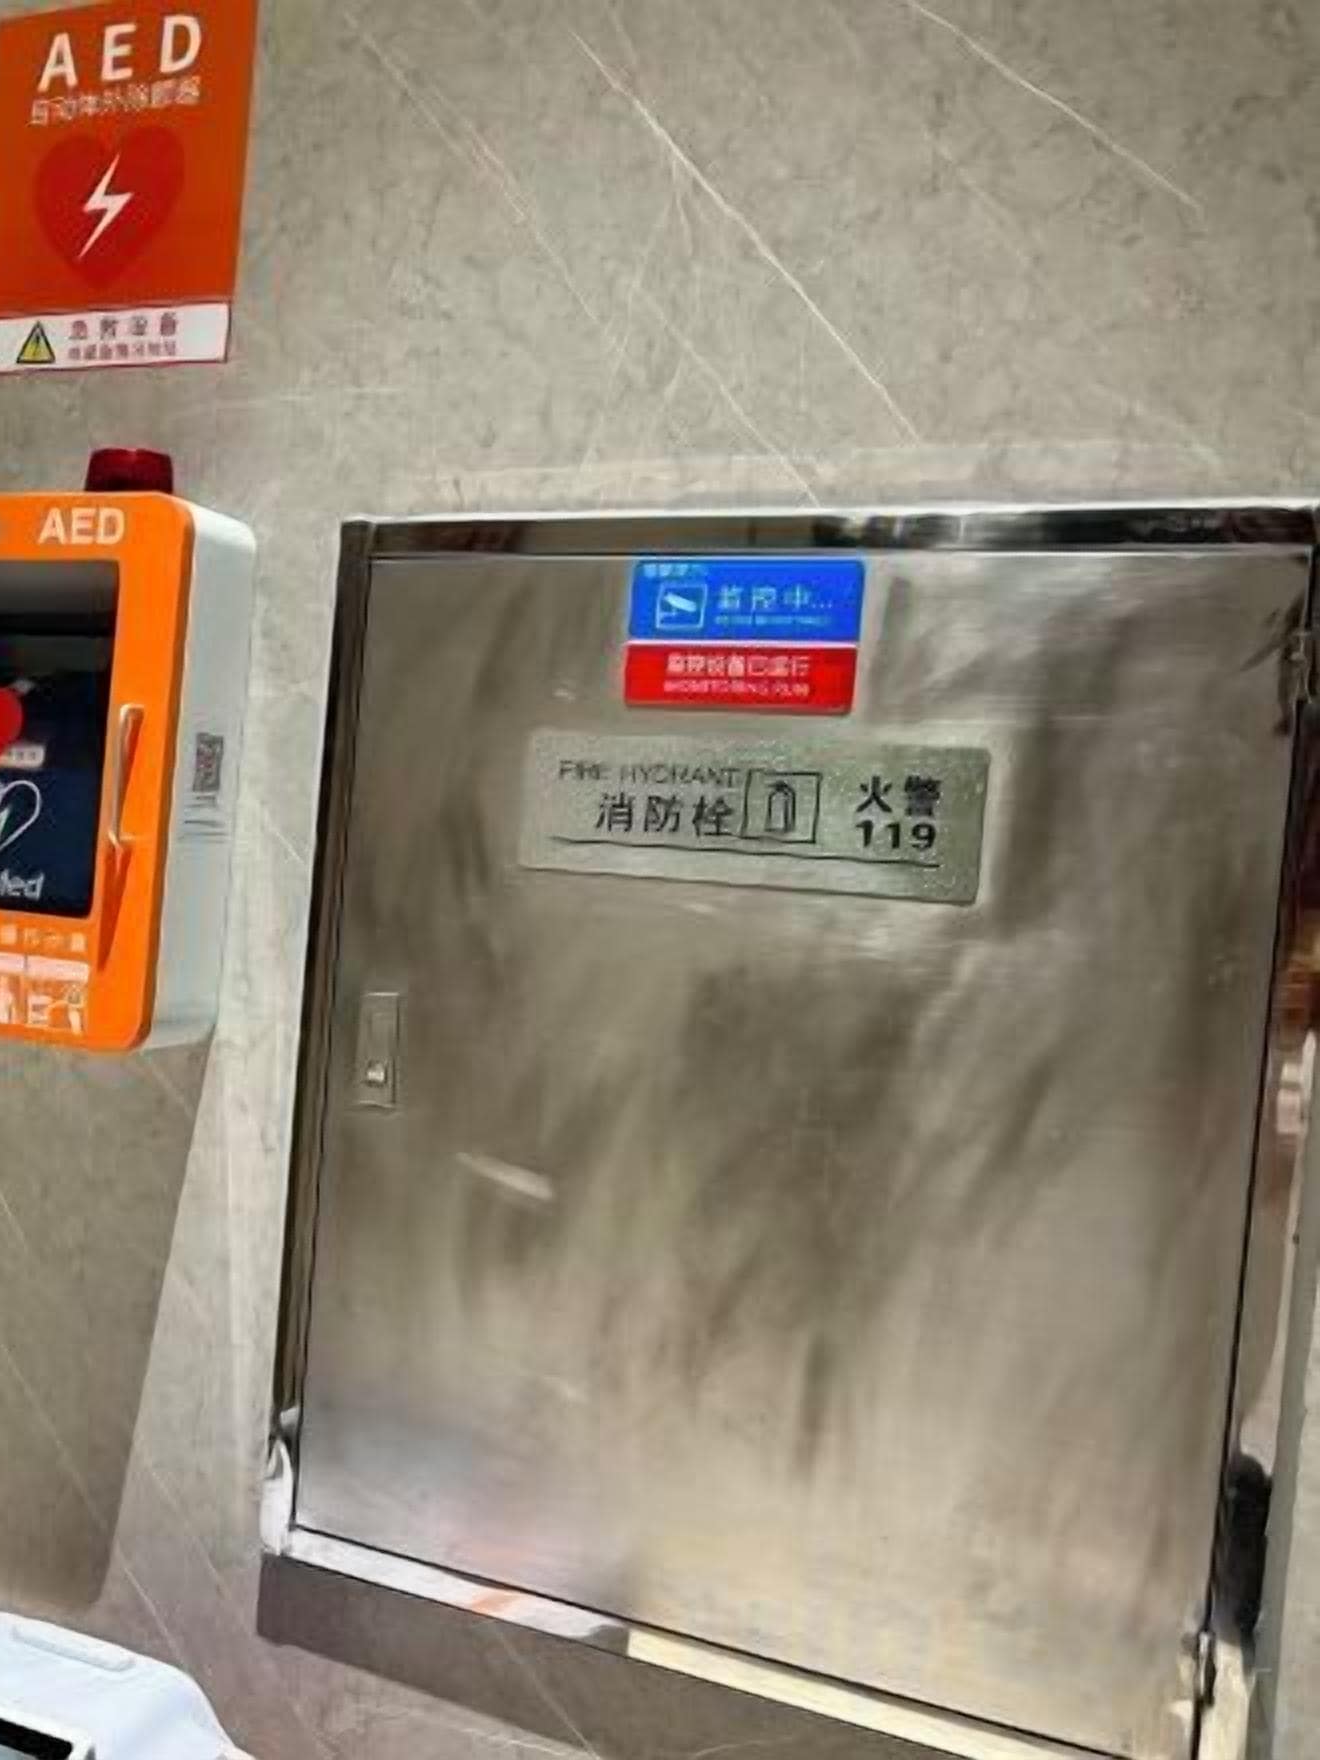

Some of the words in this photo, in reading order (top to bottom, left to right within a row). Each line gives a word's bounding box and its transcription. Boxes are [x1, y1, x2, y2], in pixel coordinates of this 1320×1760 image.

[36, 13, 202, 93] AED
[37, 506, 126, 546] AED
[596, 792, 735, 837] 消防栓
[855, 775, 942, 818] 火警
[854, 819, 937, 852] 119
